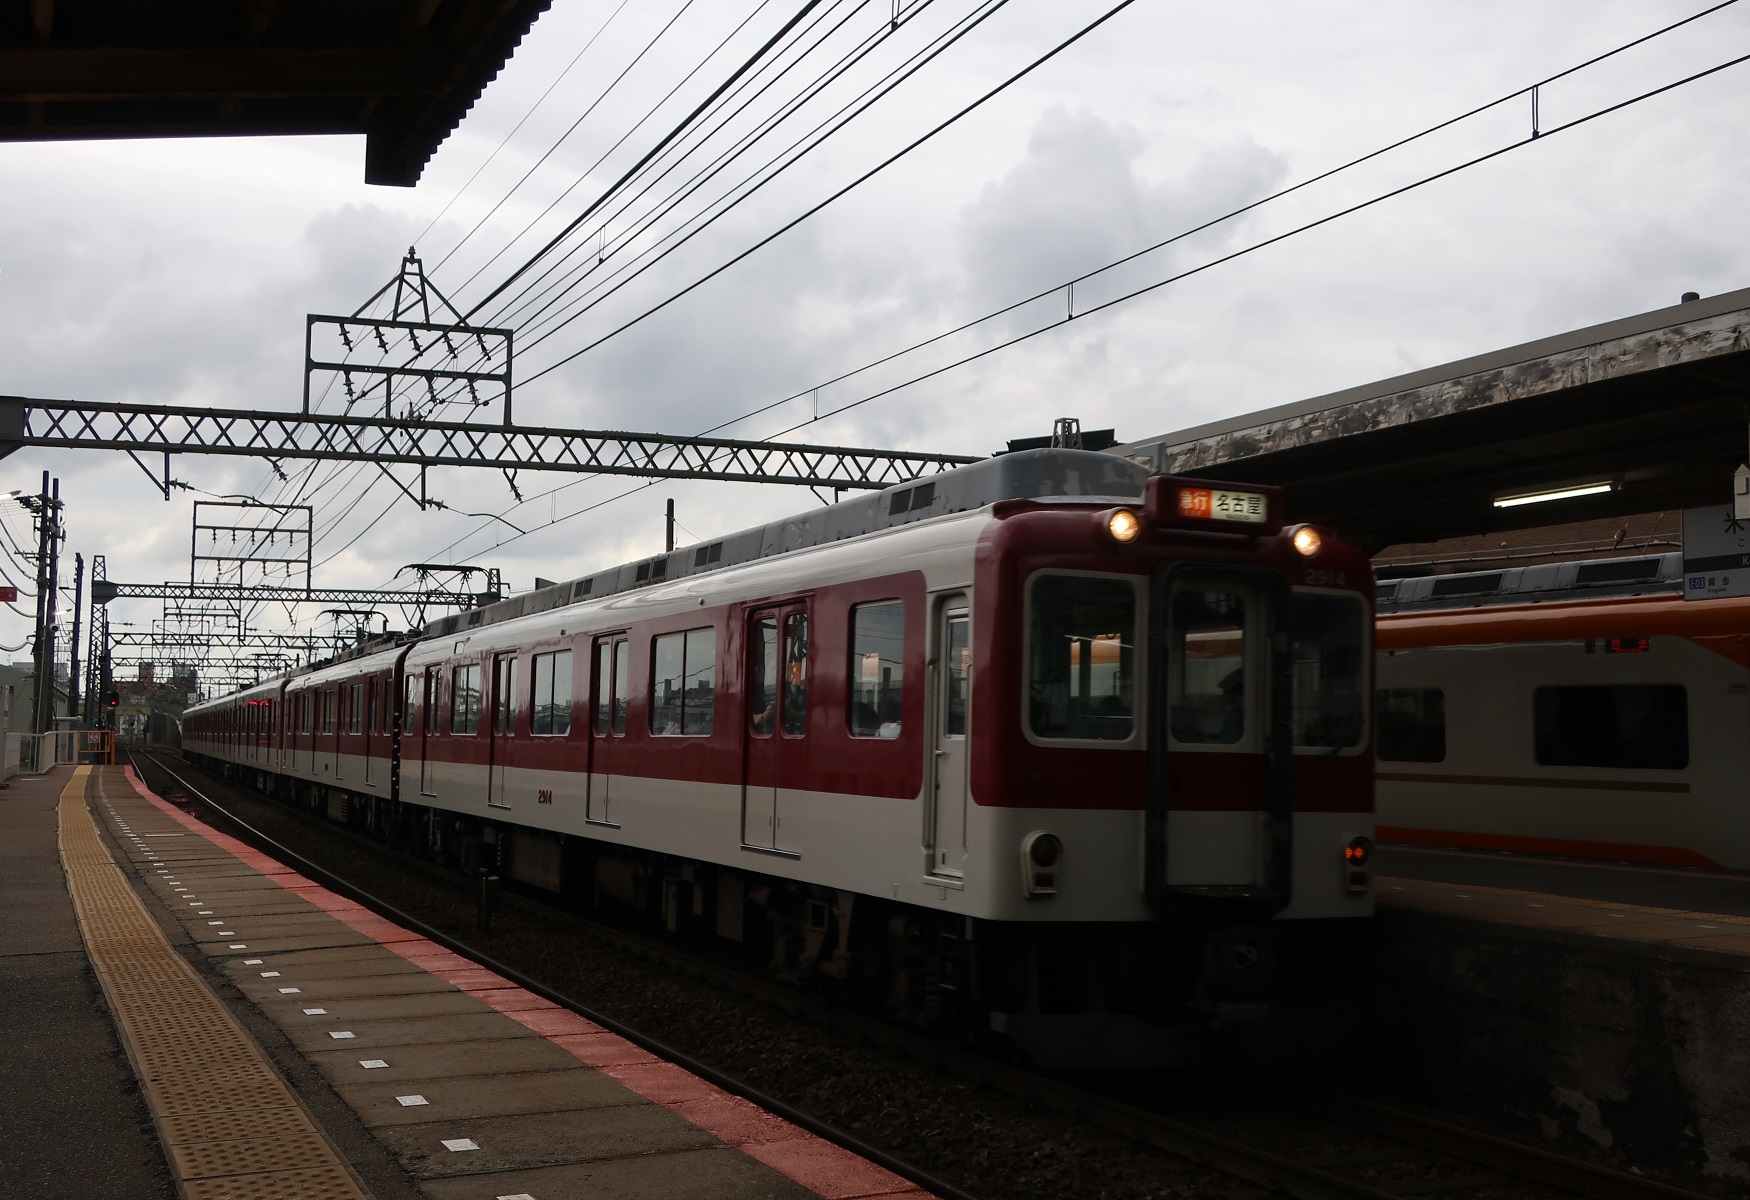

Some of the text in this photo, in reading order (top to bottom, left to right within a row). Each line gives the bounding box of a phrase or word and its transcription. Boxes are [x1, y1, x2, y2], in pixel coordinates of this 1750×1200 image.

[1179, 490, 1262, 515] 急行 名古屋
[1305, 568, 1347, 587] 2914
[538, 789, 552, 805] 2914
